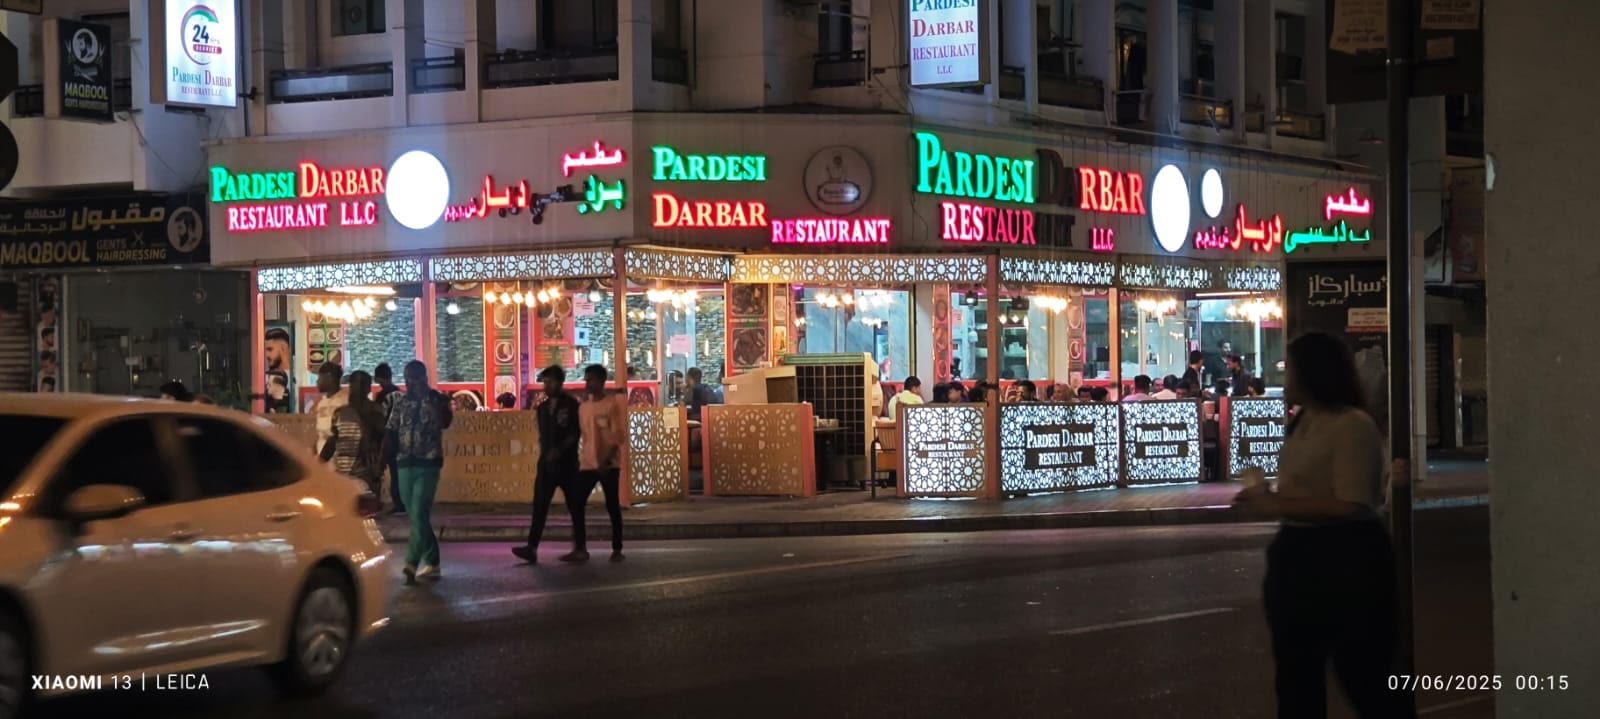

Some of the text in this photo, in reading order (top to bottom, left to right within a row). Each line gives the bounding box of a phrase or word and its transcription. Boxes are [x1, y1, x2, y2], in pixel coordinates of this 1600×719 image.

[192, 24, 209, 43] 24
[912, 18, 975, 37] DARBAR
[913, 43, 977, 60] RESTAURANT
[64, 81, 109, 100] MAQBOOL
[561, 140, 625, 178] مطعم
[652, 146, 766, 181] PARDESI
[914, 131, 1036, 204] PARDESI
[210, 162, 386, 202] PARDESI DARBAR
[652, 192, 768, 228] DARBAR
[1326, 186, 1372, 220] مطعم
[71, 202, 166, 231] مقبول
[228, 202, 328, 231] RESTAURANT
[771, 219, 890, 243] RESTAURANT
[1230, 203, 1282, 253] دربار
[0, 238, 128, 264] MAQBOOL GENTS
[96, 248, 167, 262] HAIRDRESSING
[1026, 429, 1095, 449] PARDESI DARBAR
[1136, 426, 1187, 443] PARDESI DARBAR
[1240, 421, 1267, 438] PARDESI
[928, 451, 964, 459] RESTAURANT
[1038, 451, 1083, 465] RESTAURANT
[1145, 444, 1179, 456] RESTAURANT
